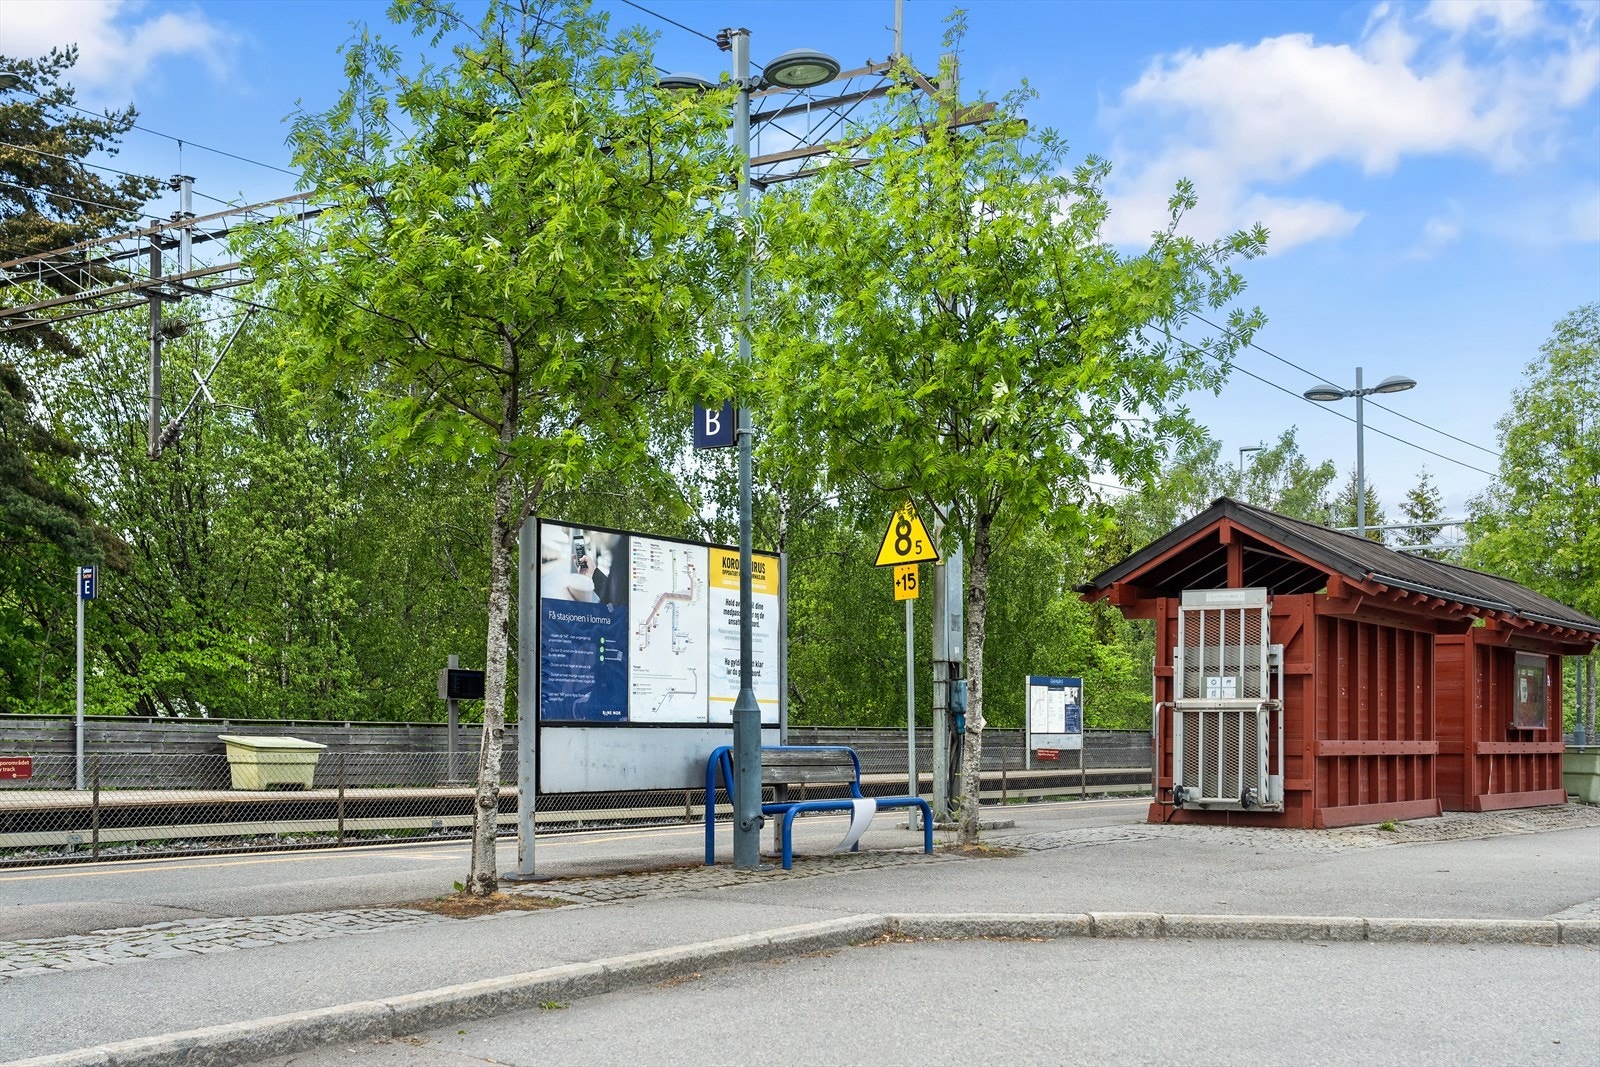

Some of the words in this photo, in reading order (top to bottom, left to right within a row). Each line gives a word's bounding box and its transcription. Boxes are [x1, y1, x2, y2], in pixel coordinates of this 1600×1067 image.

[706, 407, 720, 436] B
[894, 519, 912, 556] 8
[915, 540, 922, 555] 5
[722, 556, 765, 574] KOROIRUS
[85, 580, 90, 594] E
[896, 573, 916, 590] +15
[725, 598, 735, 606] Hold
[548, 610, 556, 620] Få
[557, 612, 586, 623] stasjonen
[589, 615, 611, 624] lomma
